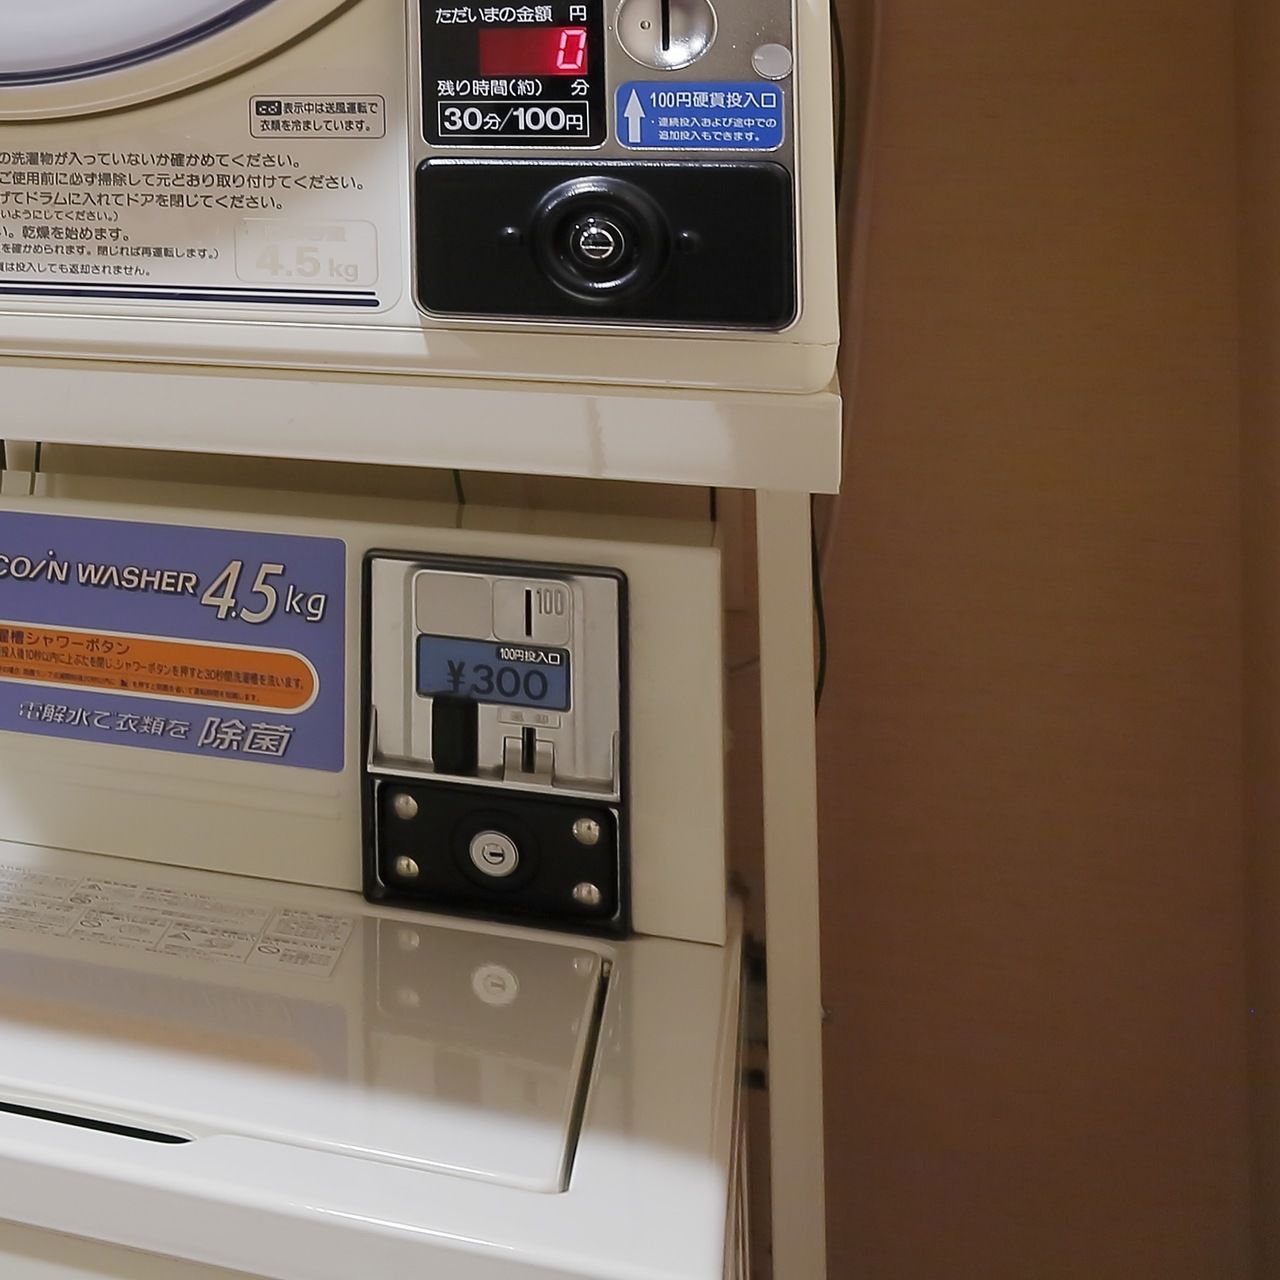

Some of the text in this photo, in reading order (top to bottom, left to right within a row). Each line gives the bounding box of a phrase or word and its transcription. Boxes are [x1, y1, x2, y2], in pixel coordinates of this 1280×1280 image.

[435, 6, 587, 23] ただいまの金額 円
[556, 28, 587, 70] 0
[571, 79, 590, 96] 分
[650, 92, 776, 109] 100円硬貨投入口
[443, 107, 583, 131] 30分/100円
[77, 563, 198, 596] WASHER
[200, 560, 285, 624] 4.5
[285, 585, 327, 622] kg
[500, 648, 560, 666] 100円投入口
[447, 659, 549, 701] ¥300
[197, 716, 295, 757] 除菌
